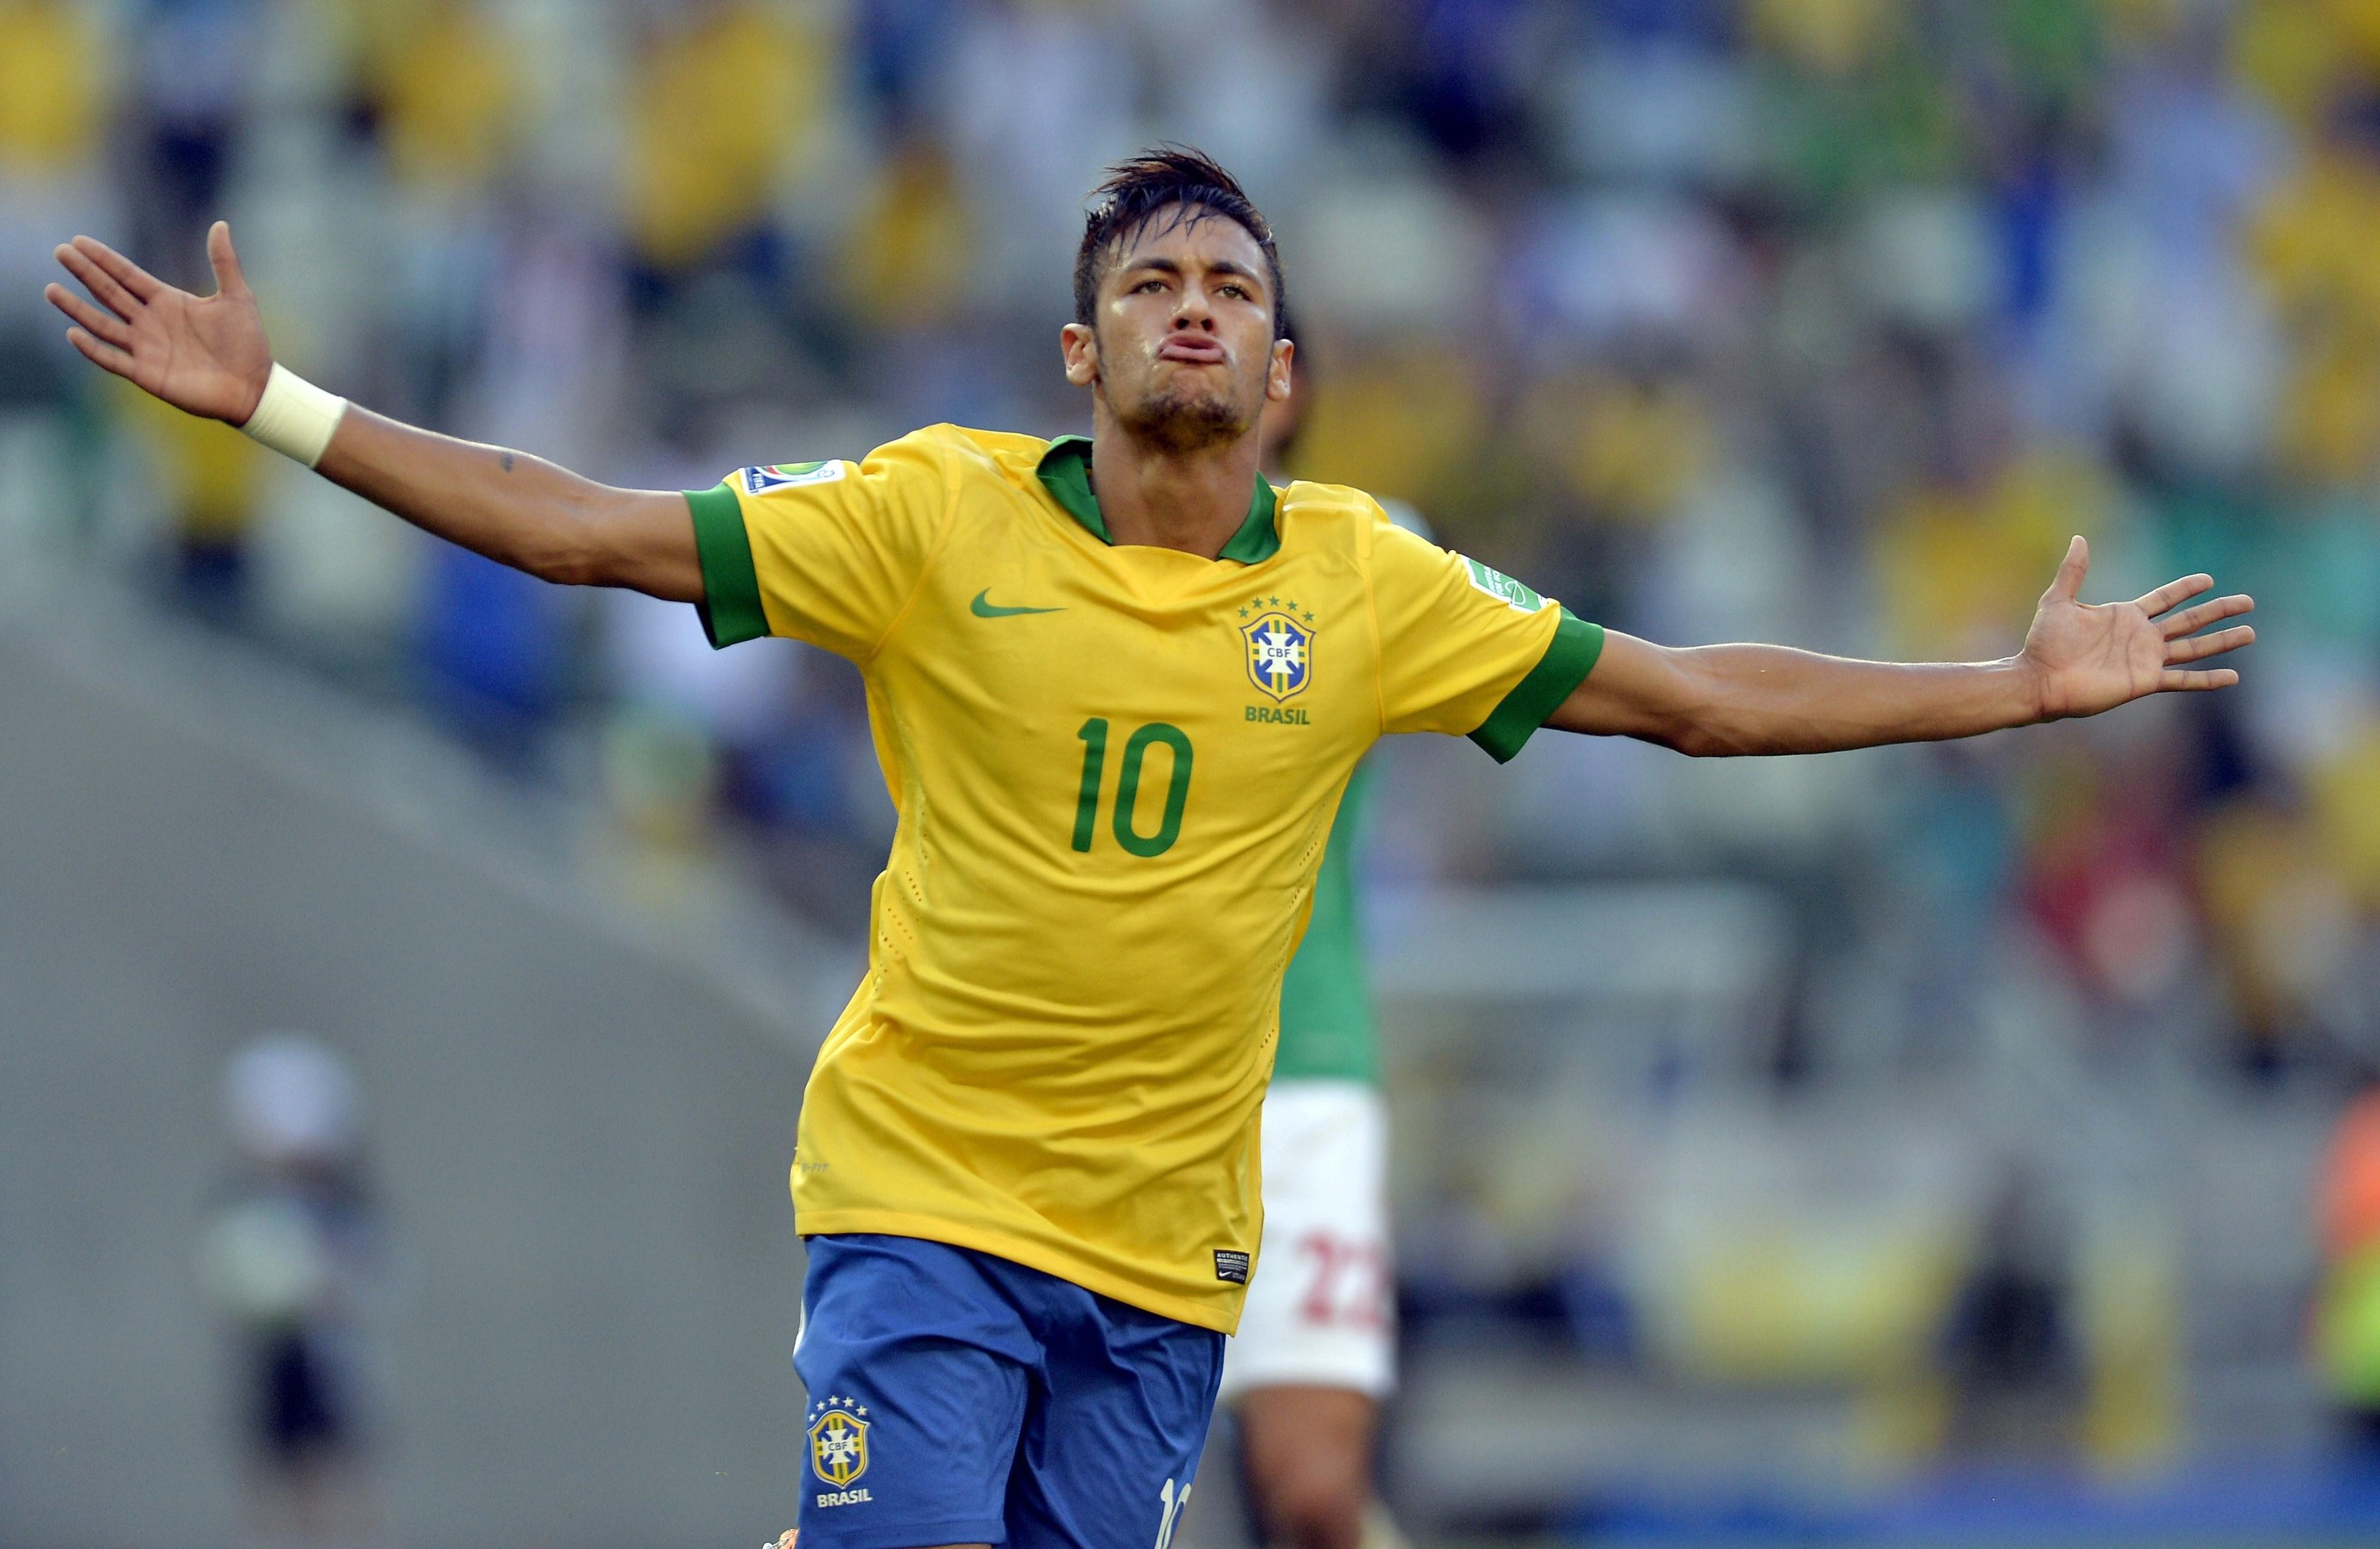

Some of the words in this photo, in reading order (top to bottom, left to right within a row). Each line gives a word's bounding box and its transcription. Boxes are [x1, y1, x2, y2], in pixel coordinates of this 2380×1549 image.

[1267, 648, 1291, 658] CBF
[1245, 706, 1311, 725] BRASIL
[1071, 717, 1194, 857] 10
[828, 1441, 848, 1451] CBF
[816, 1489, 873, 1507] BRASIL
